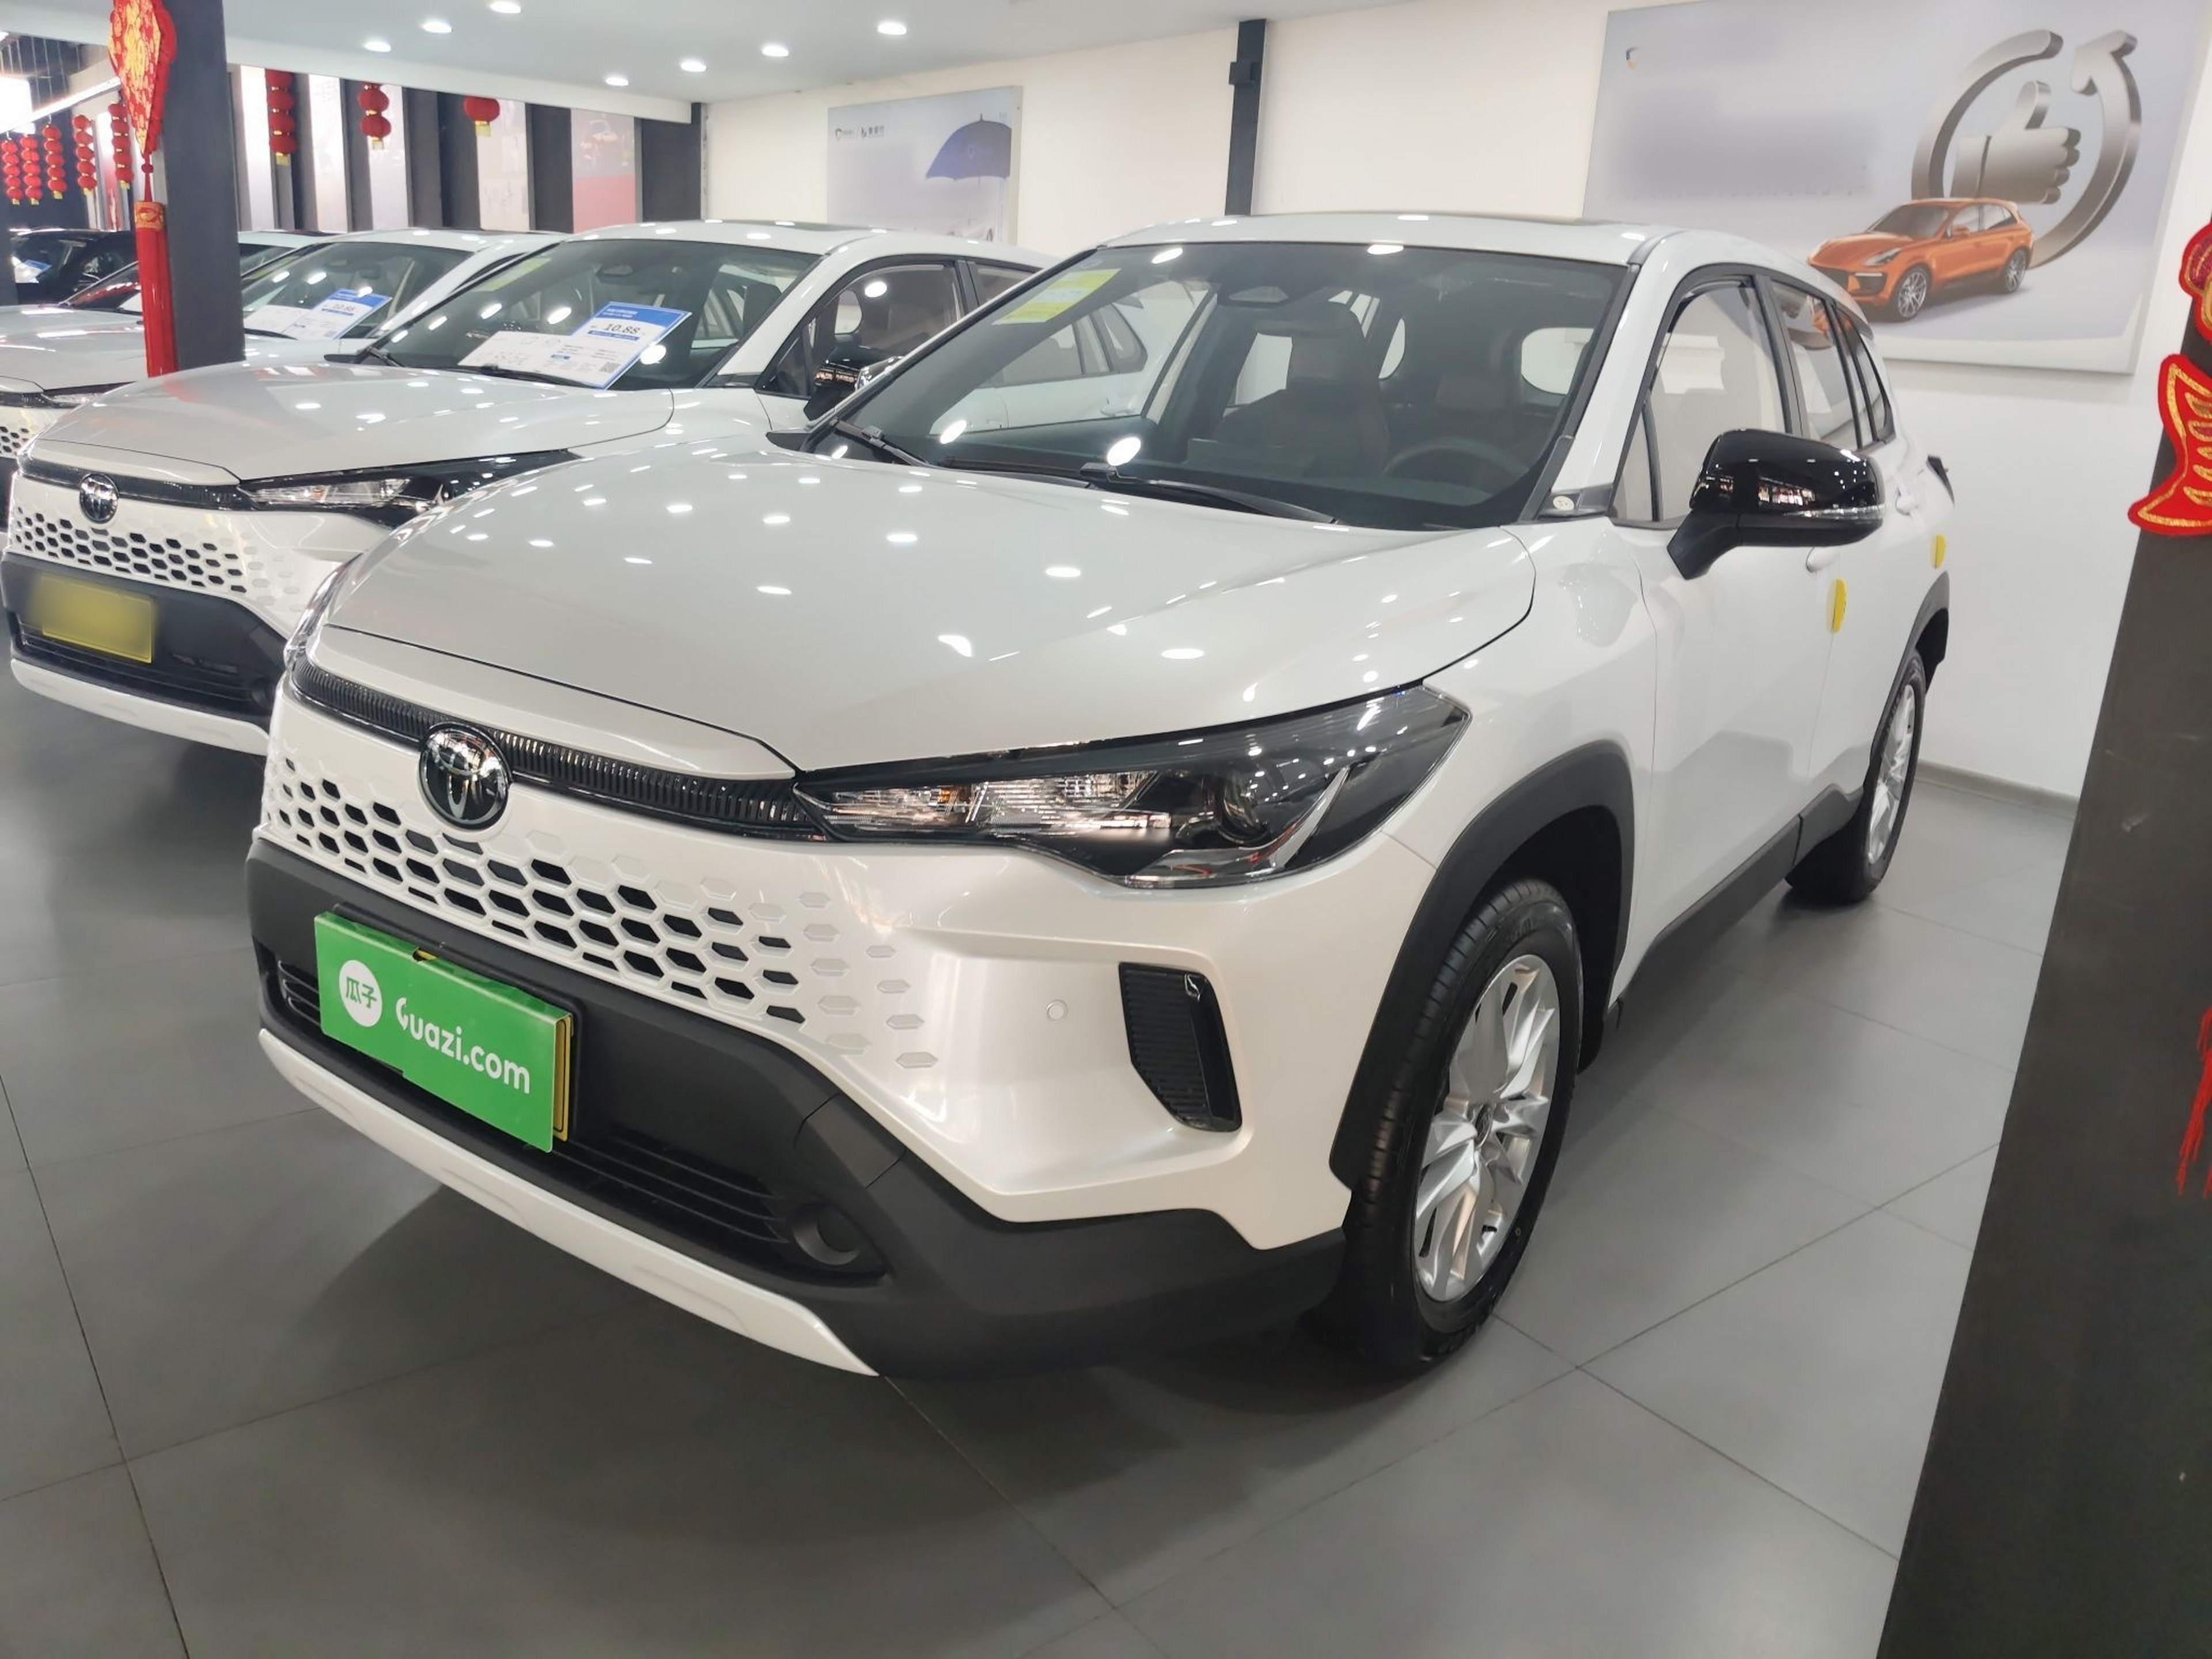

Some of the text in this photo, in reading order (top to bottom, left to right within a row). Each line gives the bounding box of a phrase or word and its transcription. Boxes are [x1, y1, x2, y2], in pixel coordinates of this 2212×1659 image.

[604, 323, 641, 334] 10.88
[346, 976, 377, 1008] 瓜子
[395, 997, 530, 1094] Guazi.com
